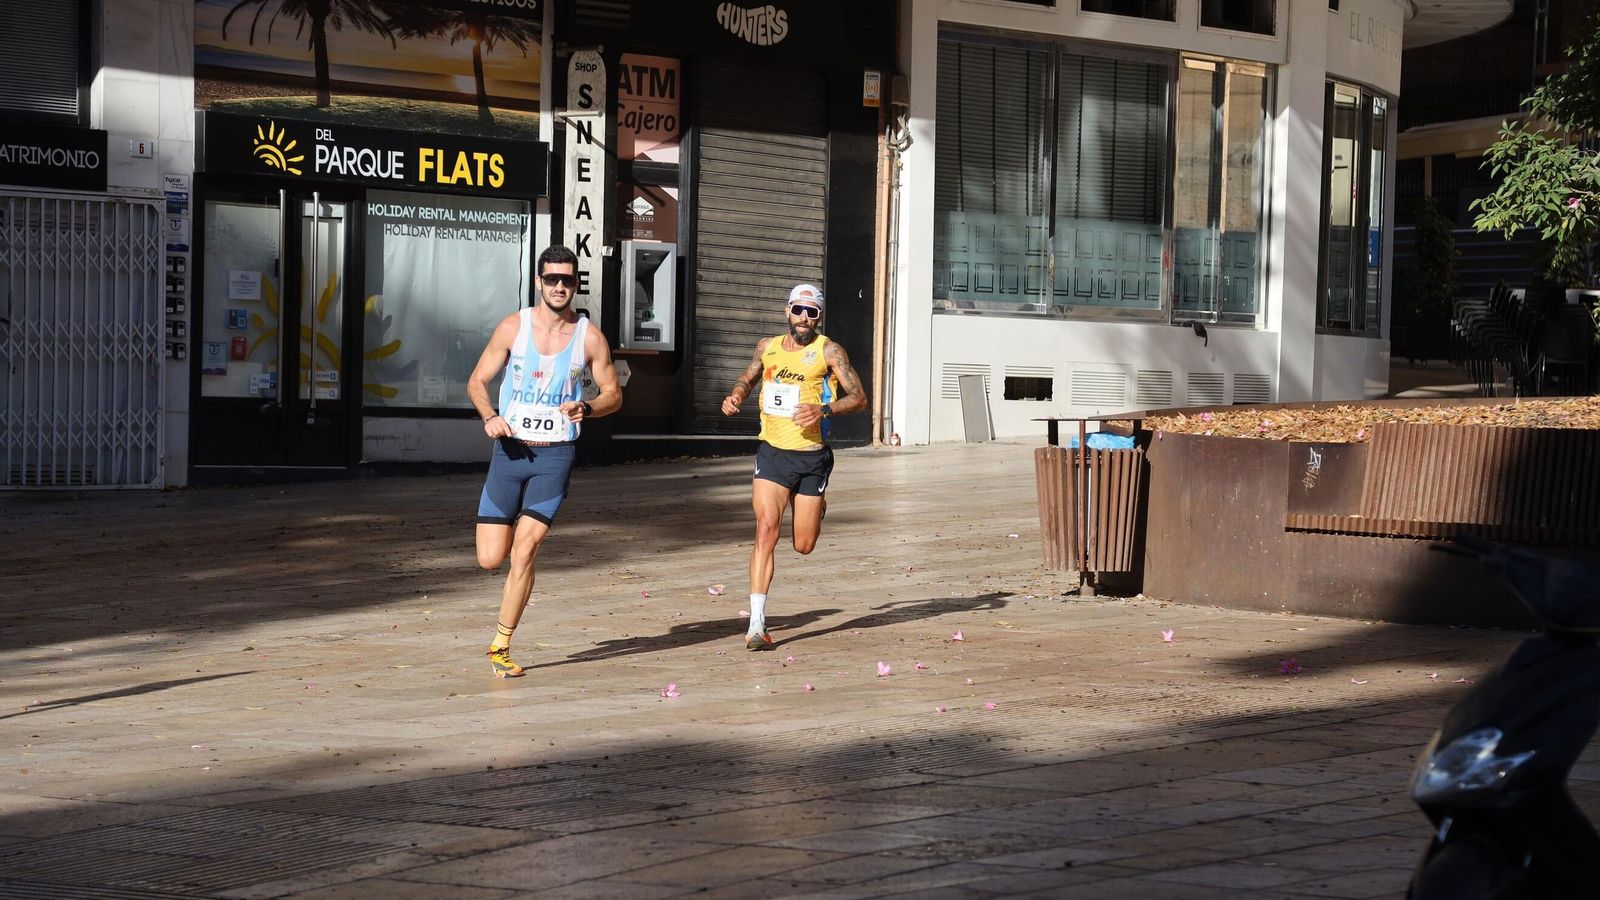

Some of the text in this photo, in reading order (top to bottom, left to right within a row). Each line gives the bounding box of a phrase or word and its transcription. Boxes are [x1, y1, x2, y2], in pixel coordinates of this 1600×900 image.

[716, 2, 789, 46] HUNTERS
[574, 62, 598, 73] SHOP
[617, 64, 676, 99] ATM
[617, 103, 676, 134] Cajero
[315, 128, 335, 142] DEL
[0, 144, 100, 169] ATRIMONIO
[139, 143, 144, 154] 6
[315, 145, 505, 188] PARQUE FLATS
[575, 84, 593, 319] SNEAKE
[367, 203, 527, 226] HOLIDAY RENTAL MANAGEMENT
[384, 223, 431, 238] HOLIDAY
[435, 227, 471, 241] RENTAL
[775, 367, 805, 382] Álora
[774, 395, 782, 406] 5
[522, 417, 554, 430] 870
